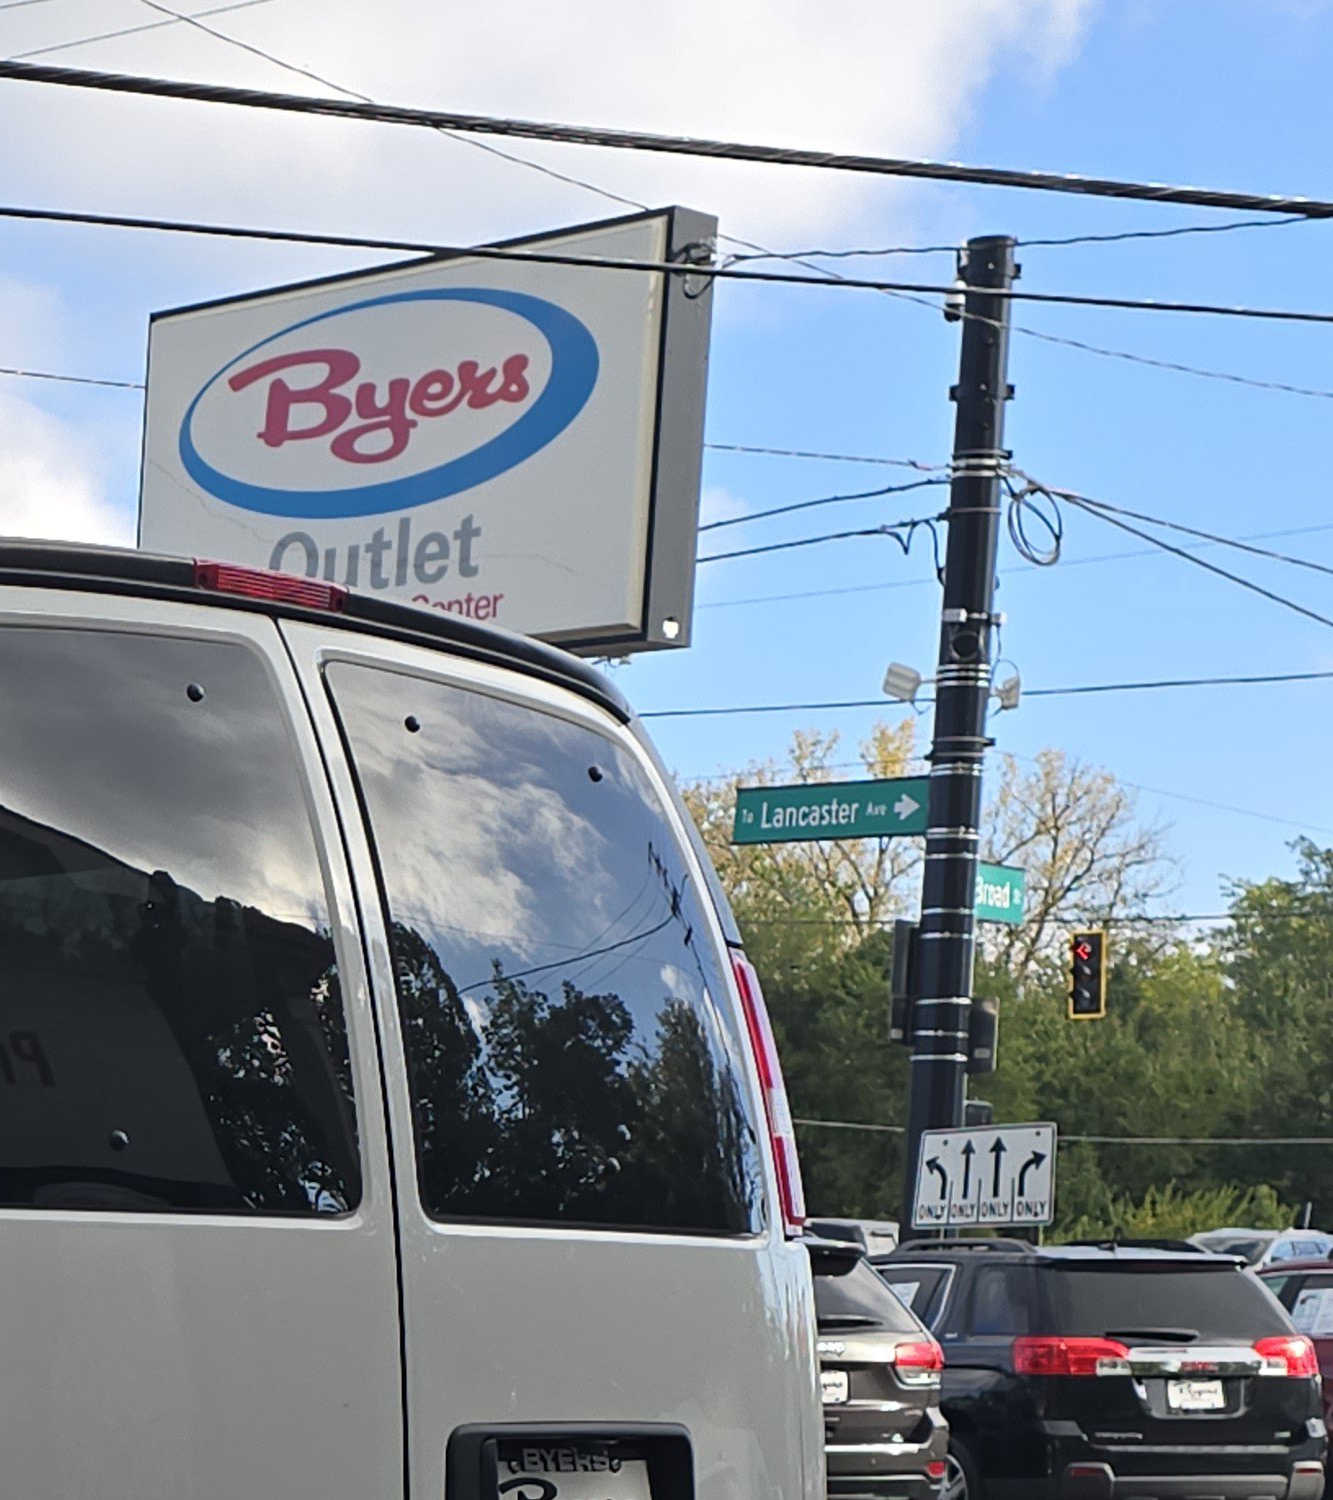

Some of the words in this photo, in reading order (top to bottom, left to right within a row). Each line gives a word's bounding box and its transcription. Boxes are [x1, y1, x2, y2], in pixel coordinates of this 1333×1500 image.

[228, 349, 530, 464] Byers
[269, 514, 482, 590] Outlet
[412, 592, 504, 620] nter
[742, 809, 754, 824] To
[761, 799, 859, 829] Lancaster
[865, 801, 887, 816] Ave
[975, 875, 1010, 909] Broad
[918, 1204, 947, 1219] ONLY
[951, 1203, 976, 1218] ONLY
[981, 1201, 1010, 1218] ONLY
[1016, 1200, 1047, 1218] ONLY
[522, 1448, 610, 1473] BYERS
